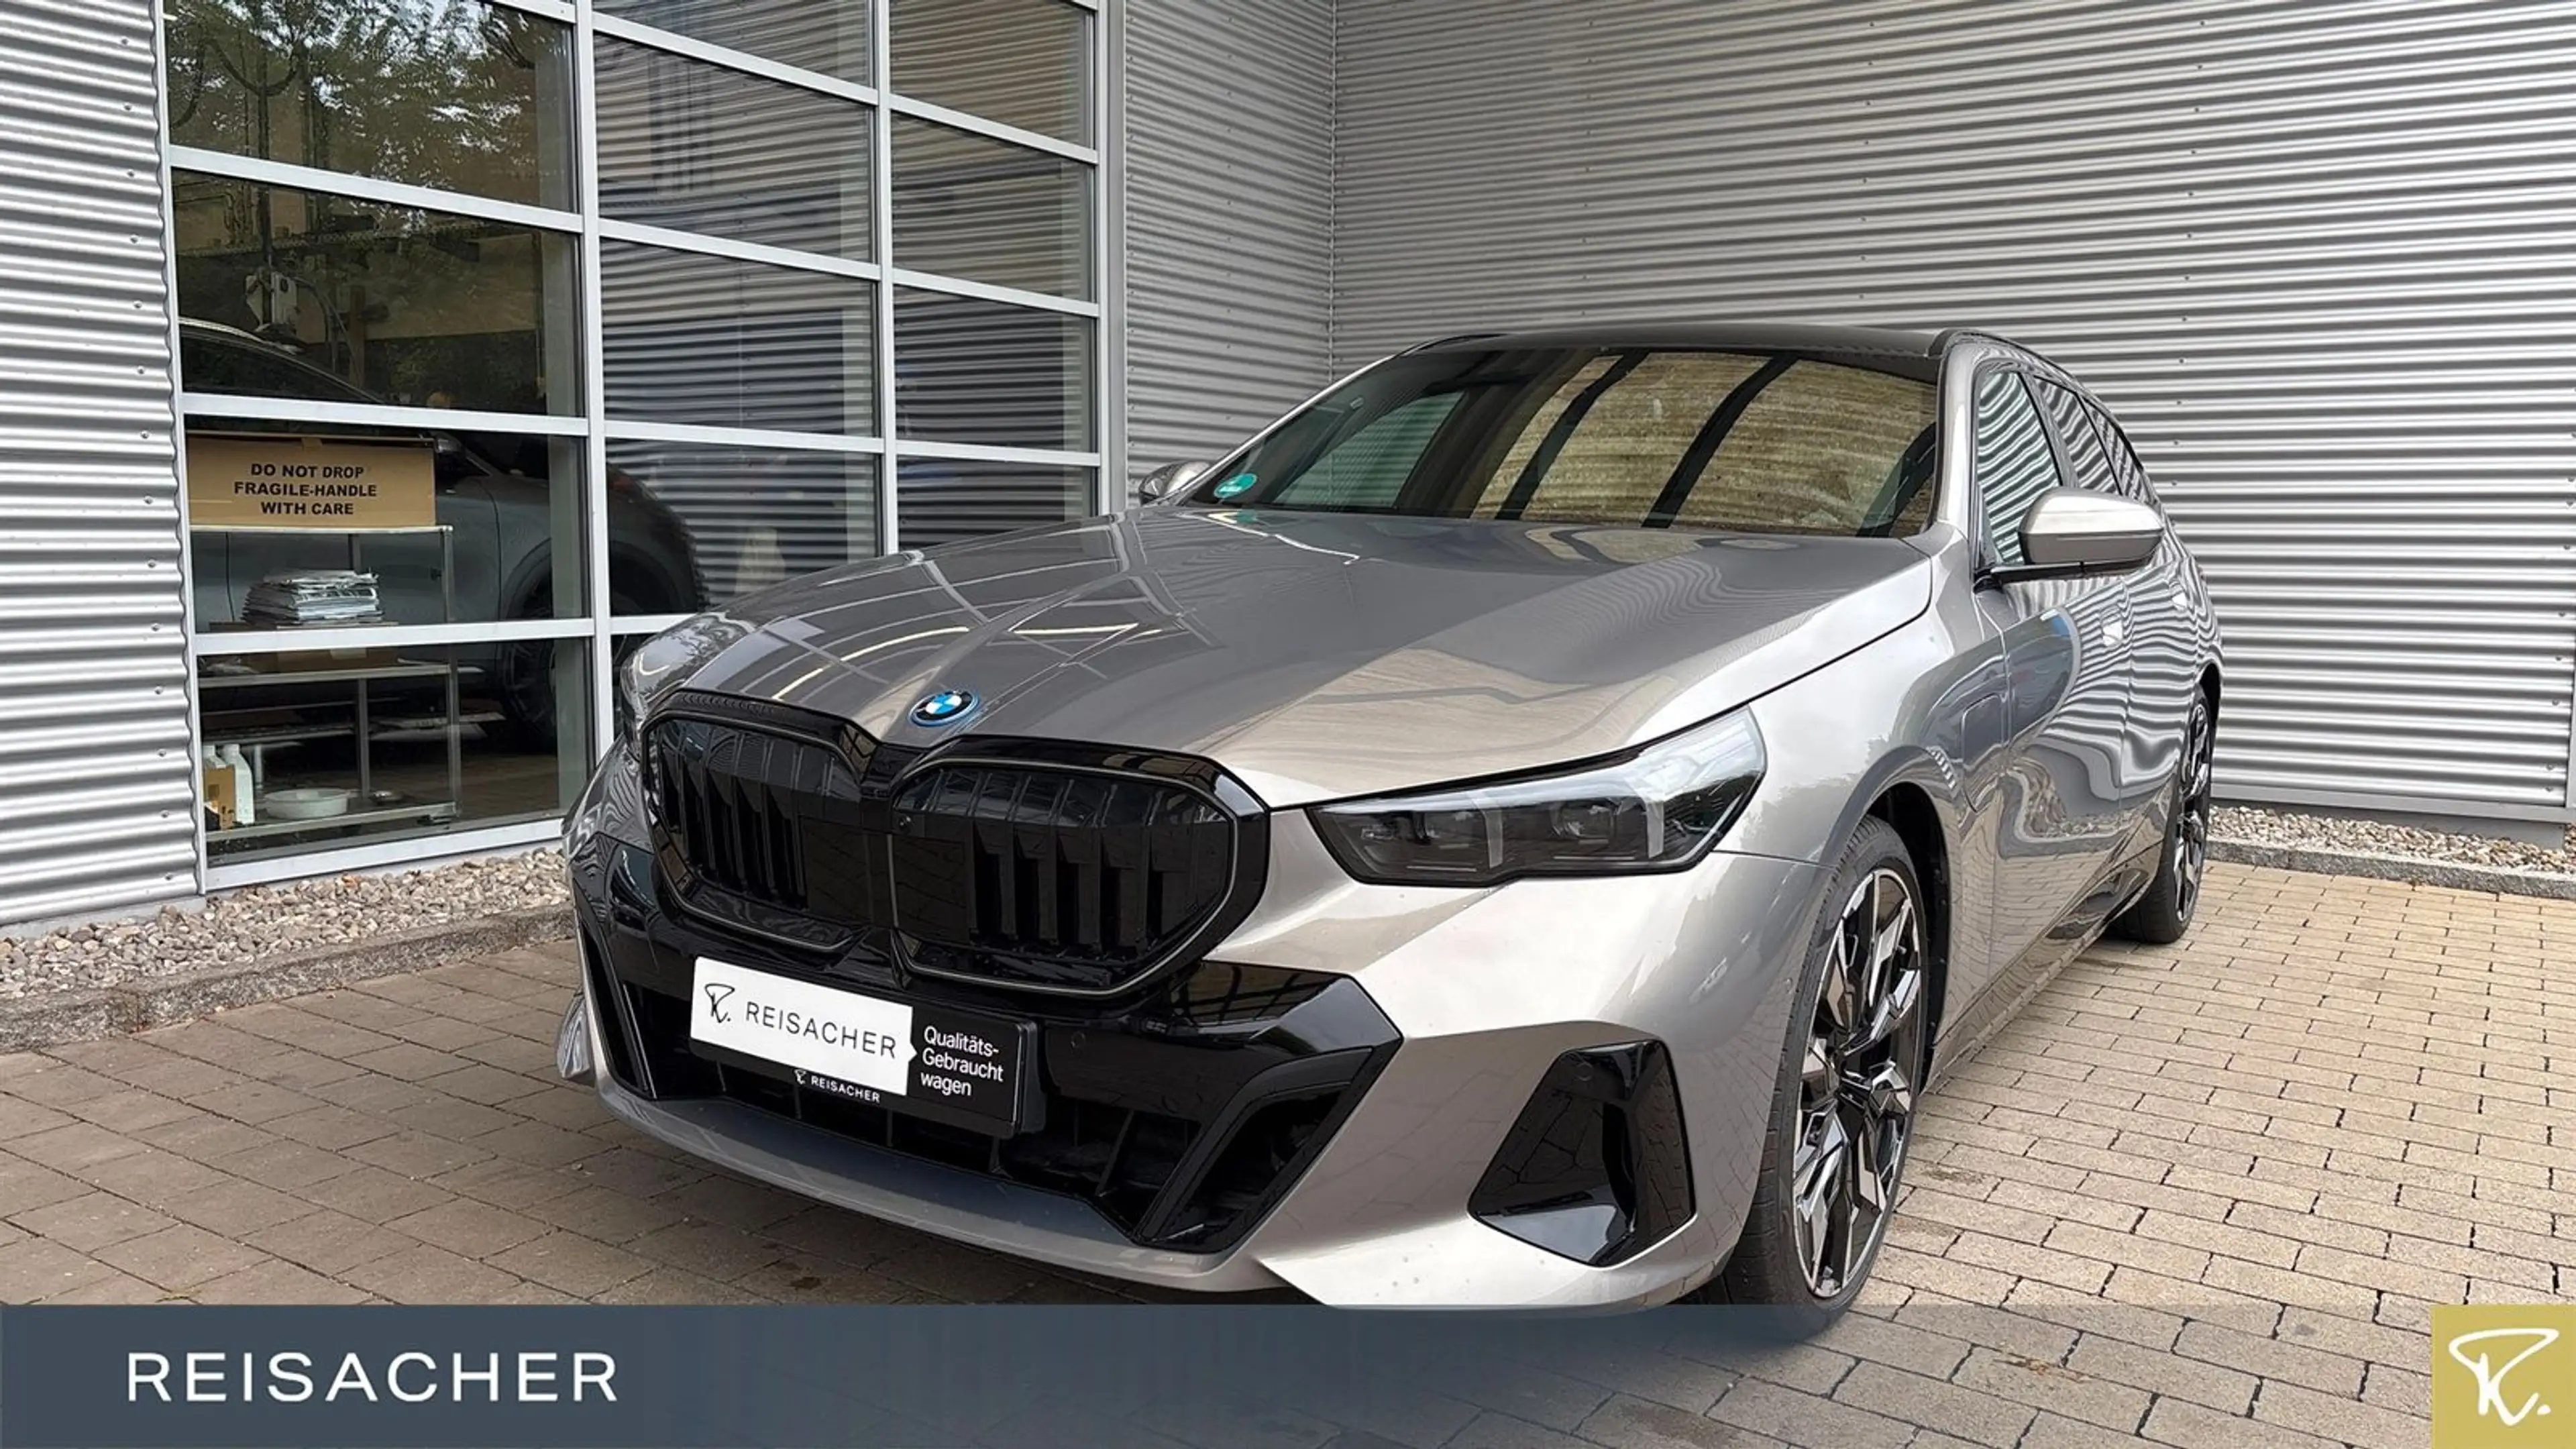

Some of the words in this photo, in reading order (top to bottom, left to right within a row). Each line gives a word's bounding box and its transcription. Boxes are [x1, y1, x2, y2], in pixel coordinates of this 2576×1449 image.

[251, 464, 276, 476] DO
[282, 465, 317, 478] NOT
[322, 466, 364, 478] DROP
[234, 481, 377, 497] FRAGILE-HANDLE
[260, 502, 306, 515] WITH
[311, 503, 354, 515] CARE
[745, 1002, 896, 1059] REISACHER
[924, 1025, 1000, 1057] Qualitäts-
[922, 1047, 1004, 1082] Gebraucht
[810, 1075, 881, 1104] REISACHER
[920, 1072, 971, 1096] wagen
